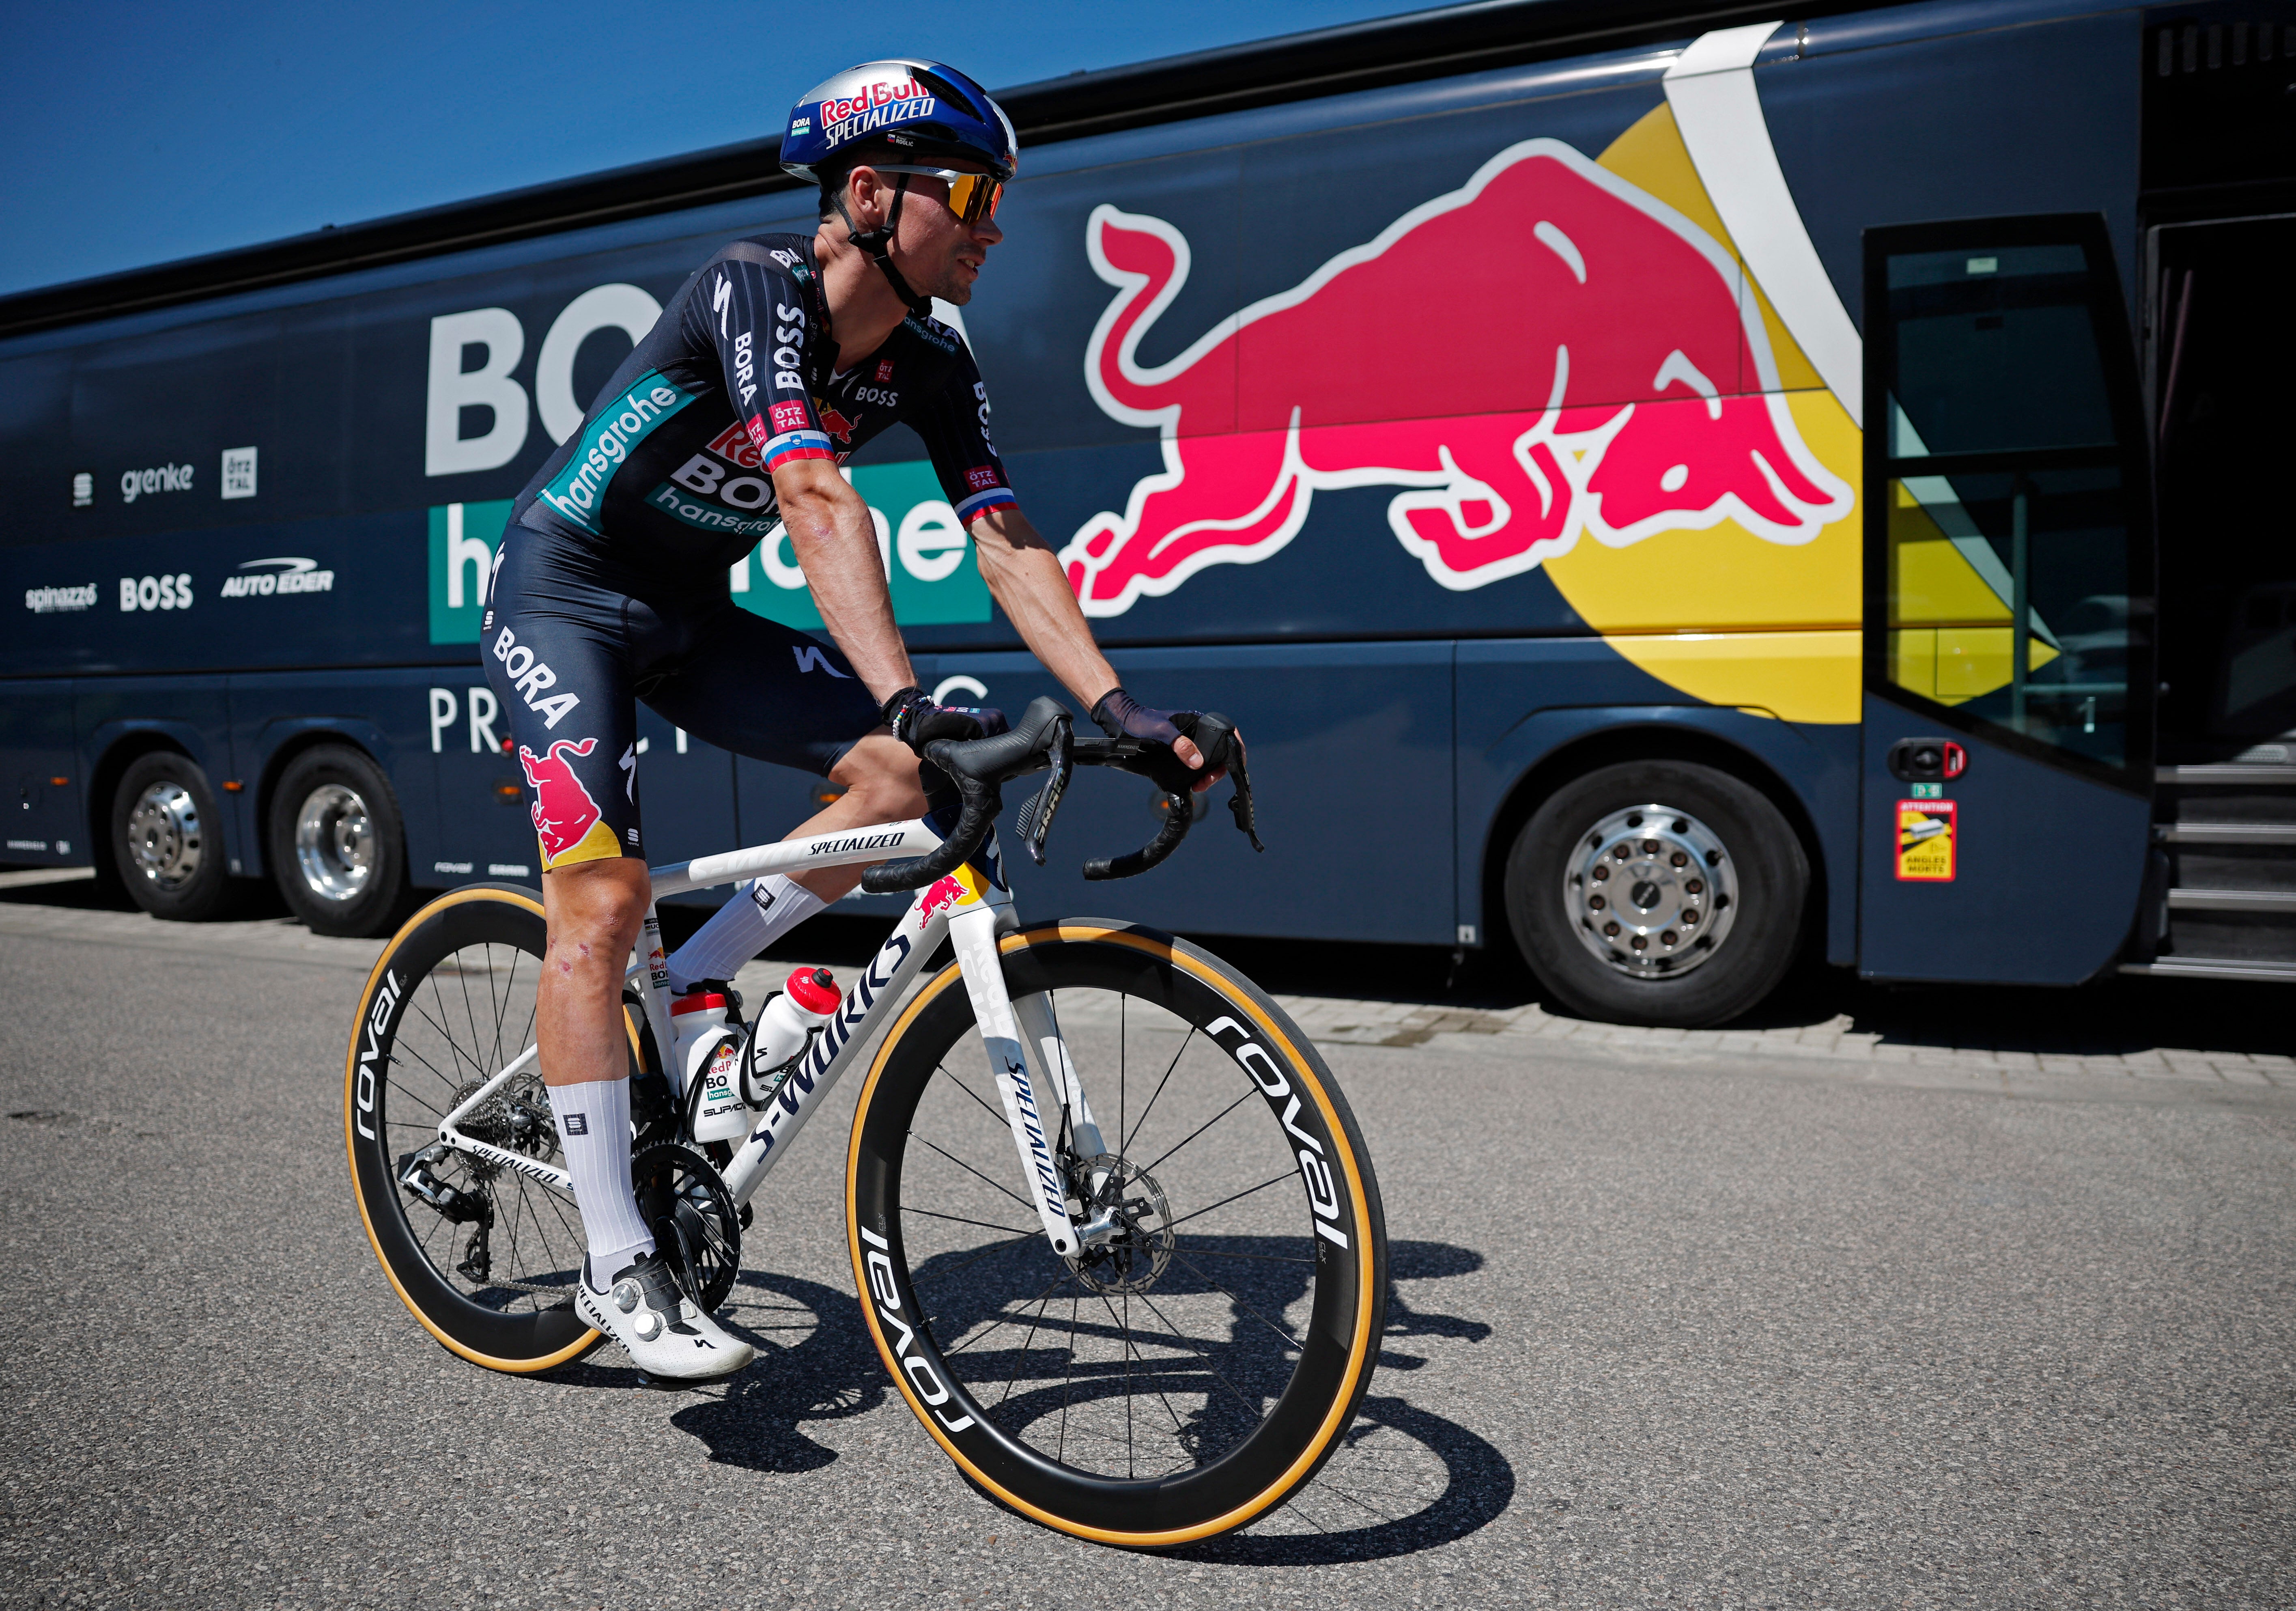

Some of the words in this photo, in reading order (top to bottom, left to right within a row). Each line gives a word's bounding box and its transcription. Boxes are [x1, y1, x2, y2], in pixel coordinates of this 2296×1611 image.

[820, 86, 871, 130] Red
[872, 75, 930, 108] Bull
[792, 117, 810, 129] BORA
[826, 98, 935, 150] SPECIALIZED
[773, 303, 805, 390] BOSS
[904, 317, 955, 351] ansgrohe
[735, 331, 757, 407] BORA
[879, 373, 889, 381] TAL
[880, 363, 892, 373] ÖTZ
[775, 407, 802, 419] ÖTZ
[855, 386, 899, 407] BOSS
[748, 422, 762, 441] ÖTZ
[777, 416, 805, 428] TAL
[542, 387, 677, 526] hansgrohe
[969, 470, 993, 480] ÖTZ
[121, 462, 194, 503] grenke
[120, 573, 193, 612] BOSS
[221, 573, 275, 597] AUTO
[276, 570, 334, 594] EDER
[493, 626, 581, 730] BORA
[1034, 767, 1065, 844] SRAM
[1900, 802, 1953, 812] ATTENTION
[807, 832, 905, 856] SPECIALIZED
[650, 961, 664, 971] Red
[357, 969, 401, 1140] roval
[751, 934, 911, 1165] S-WORKS
[1005, 1056, 1065, 1218] SPECIALIZED
[1205, 1016, 1348, 1250] roval
[472, 1145, 559, 1183] SPECIALIZED
[861, 1225, 975, 1432] roval
